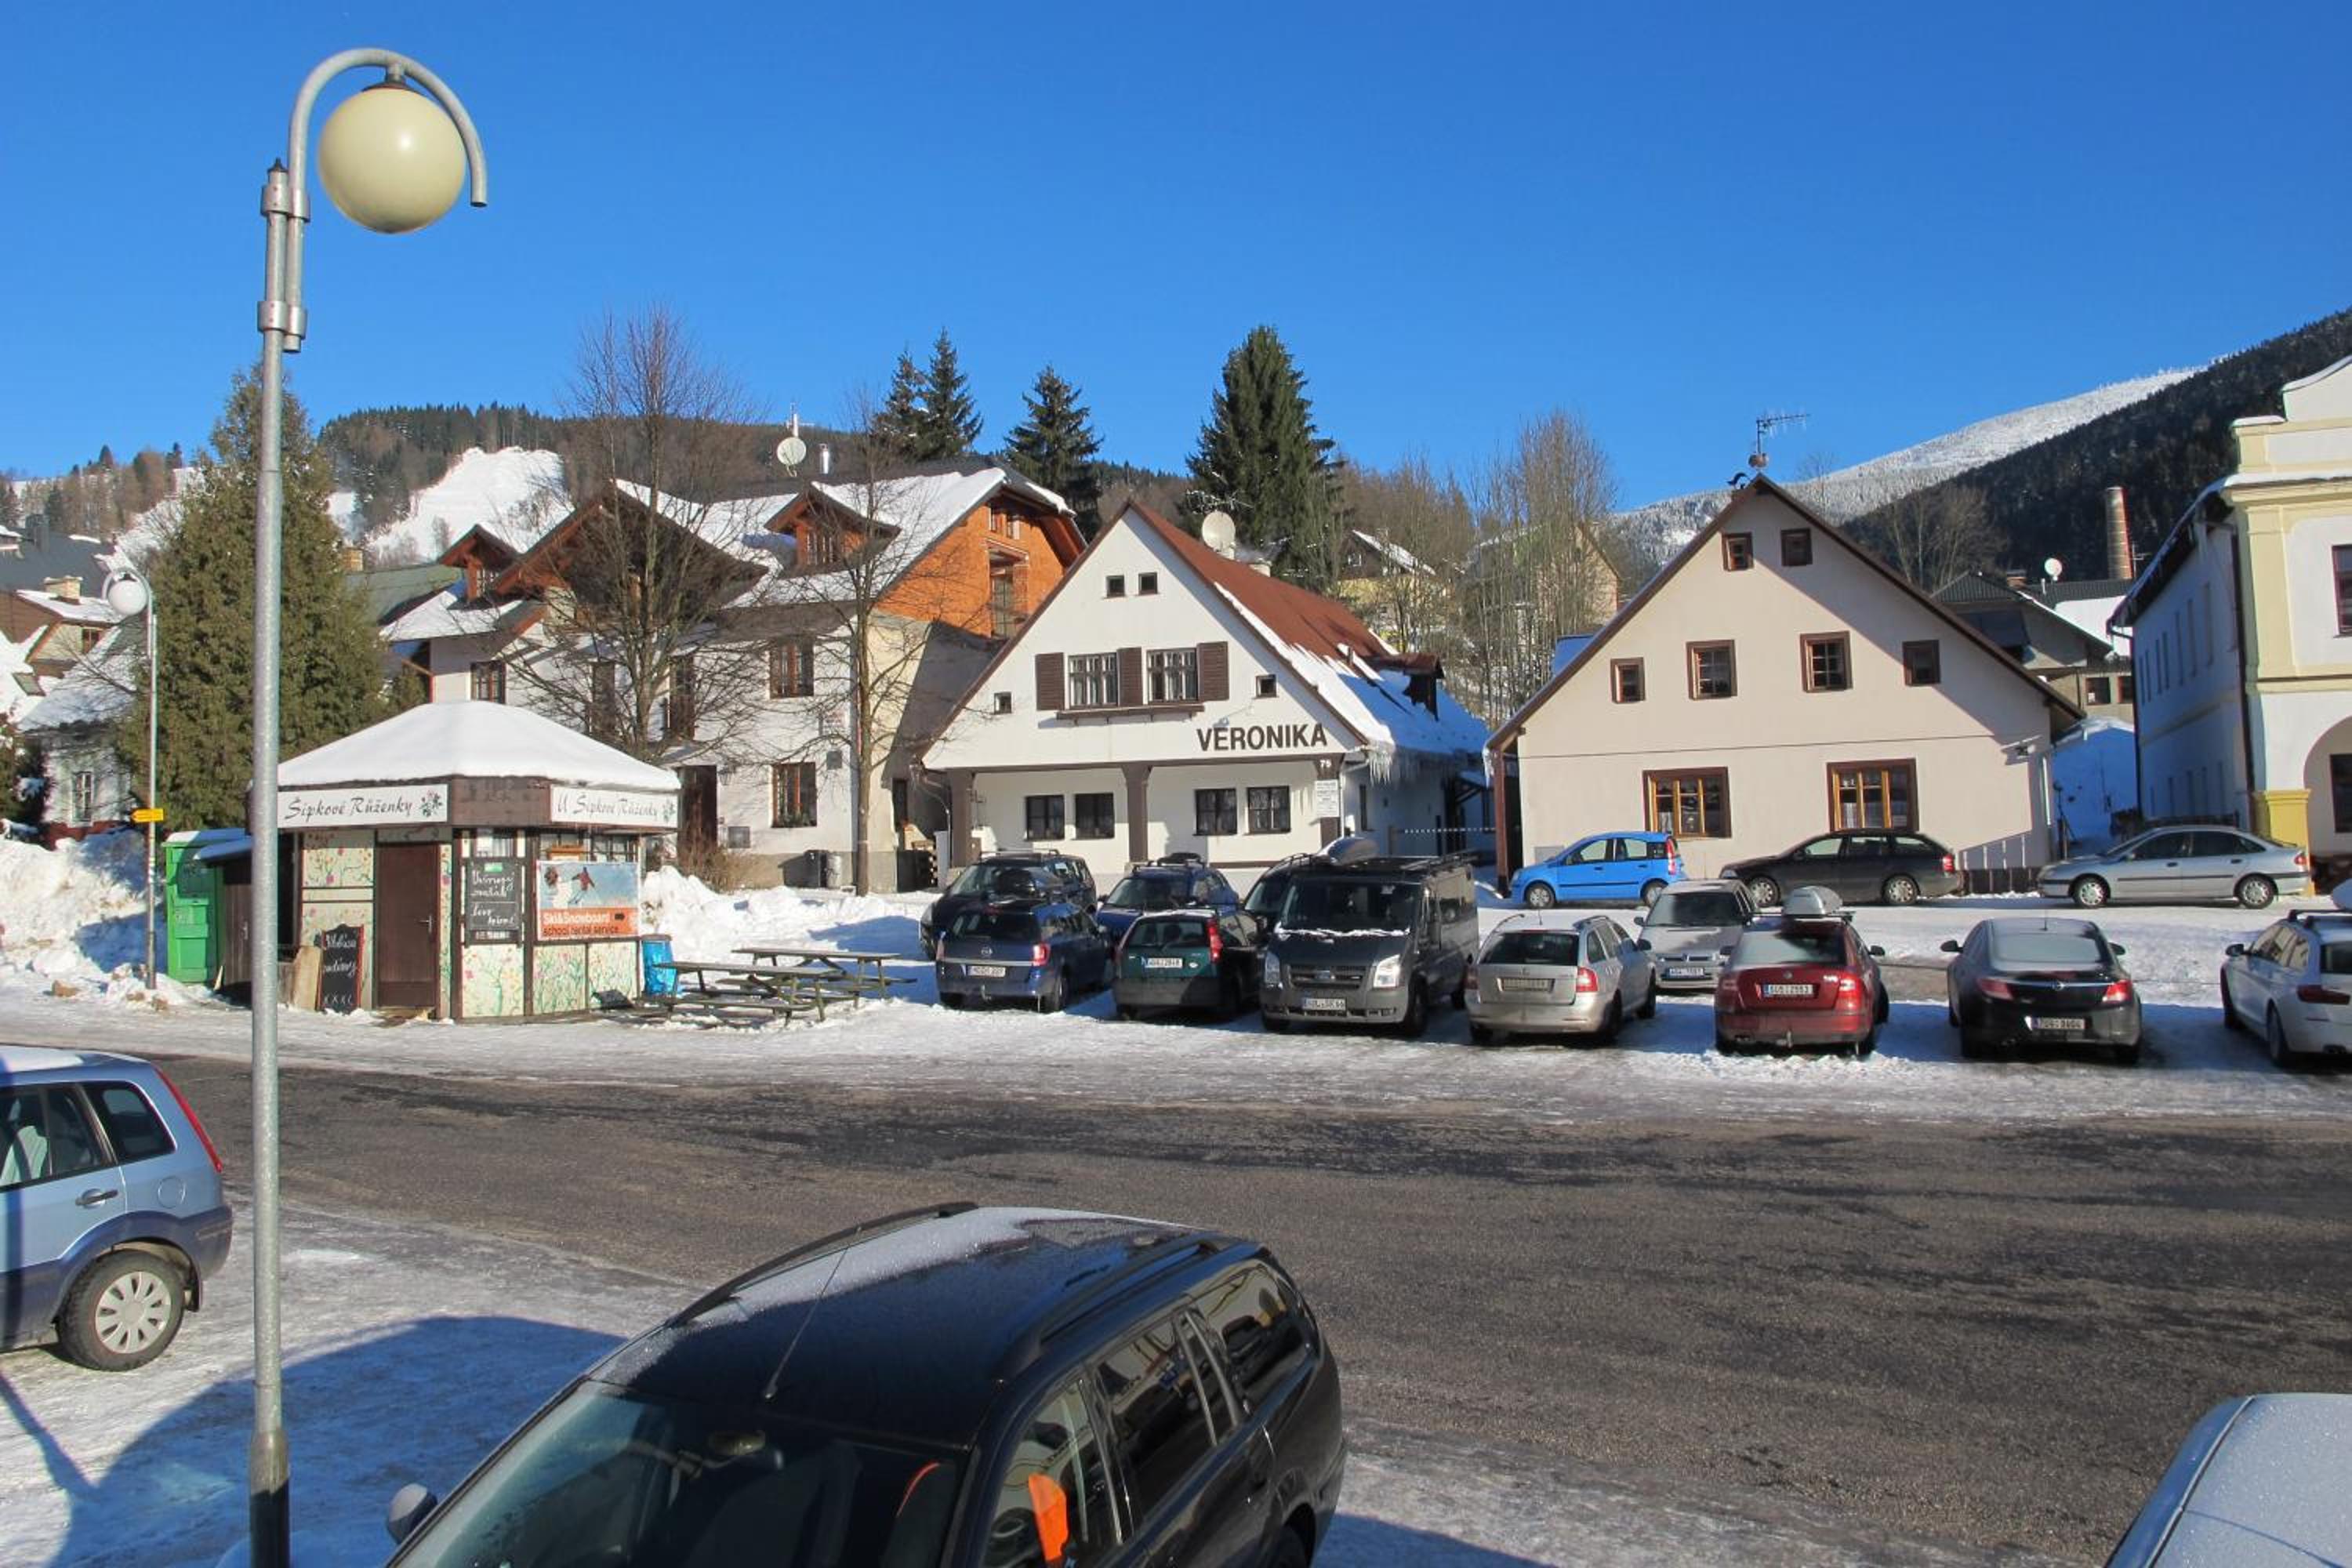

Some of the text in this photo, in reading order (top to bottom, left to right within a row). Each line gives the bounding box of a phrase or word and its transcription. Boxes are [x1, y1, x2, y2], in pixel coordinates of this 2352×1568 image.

[1196, 723, 1327, 751] VERONIKA
[285, 796, 412, 822] Šipkové Růženky
[543, 924, 619, 936] school rental service
